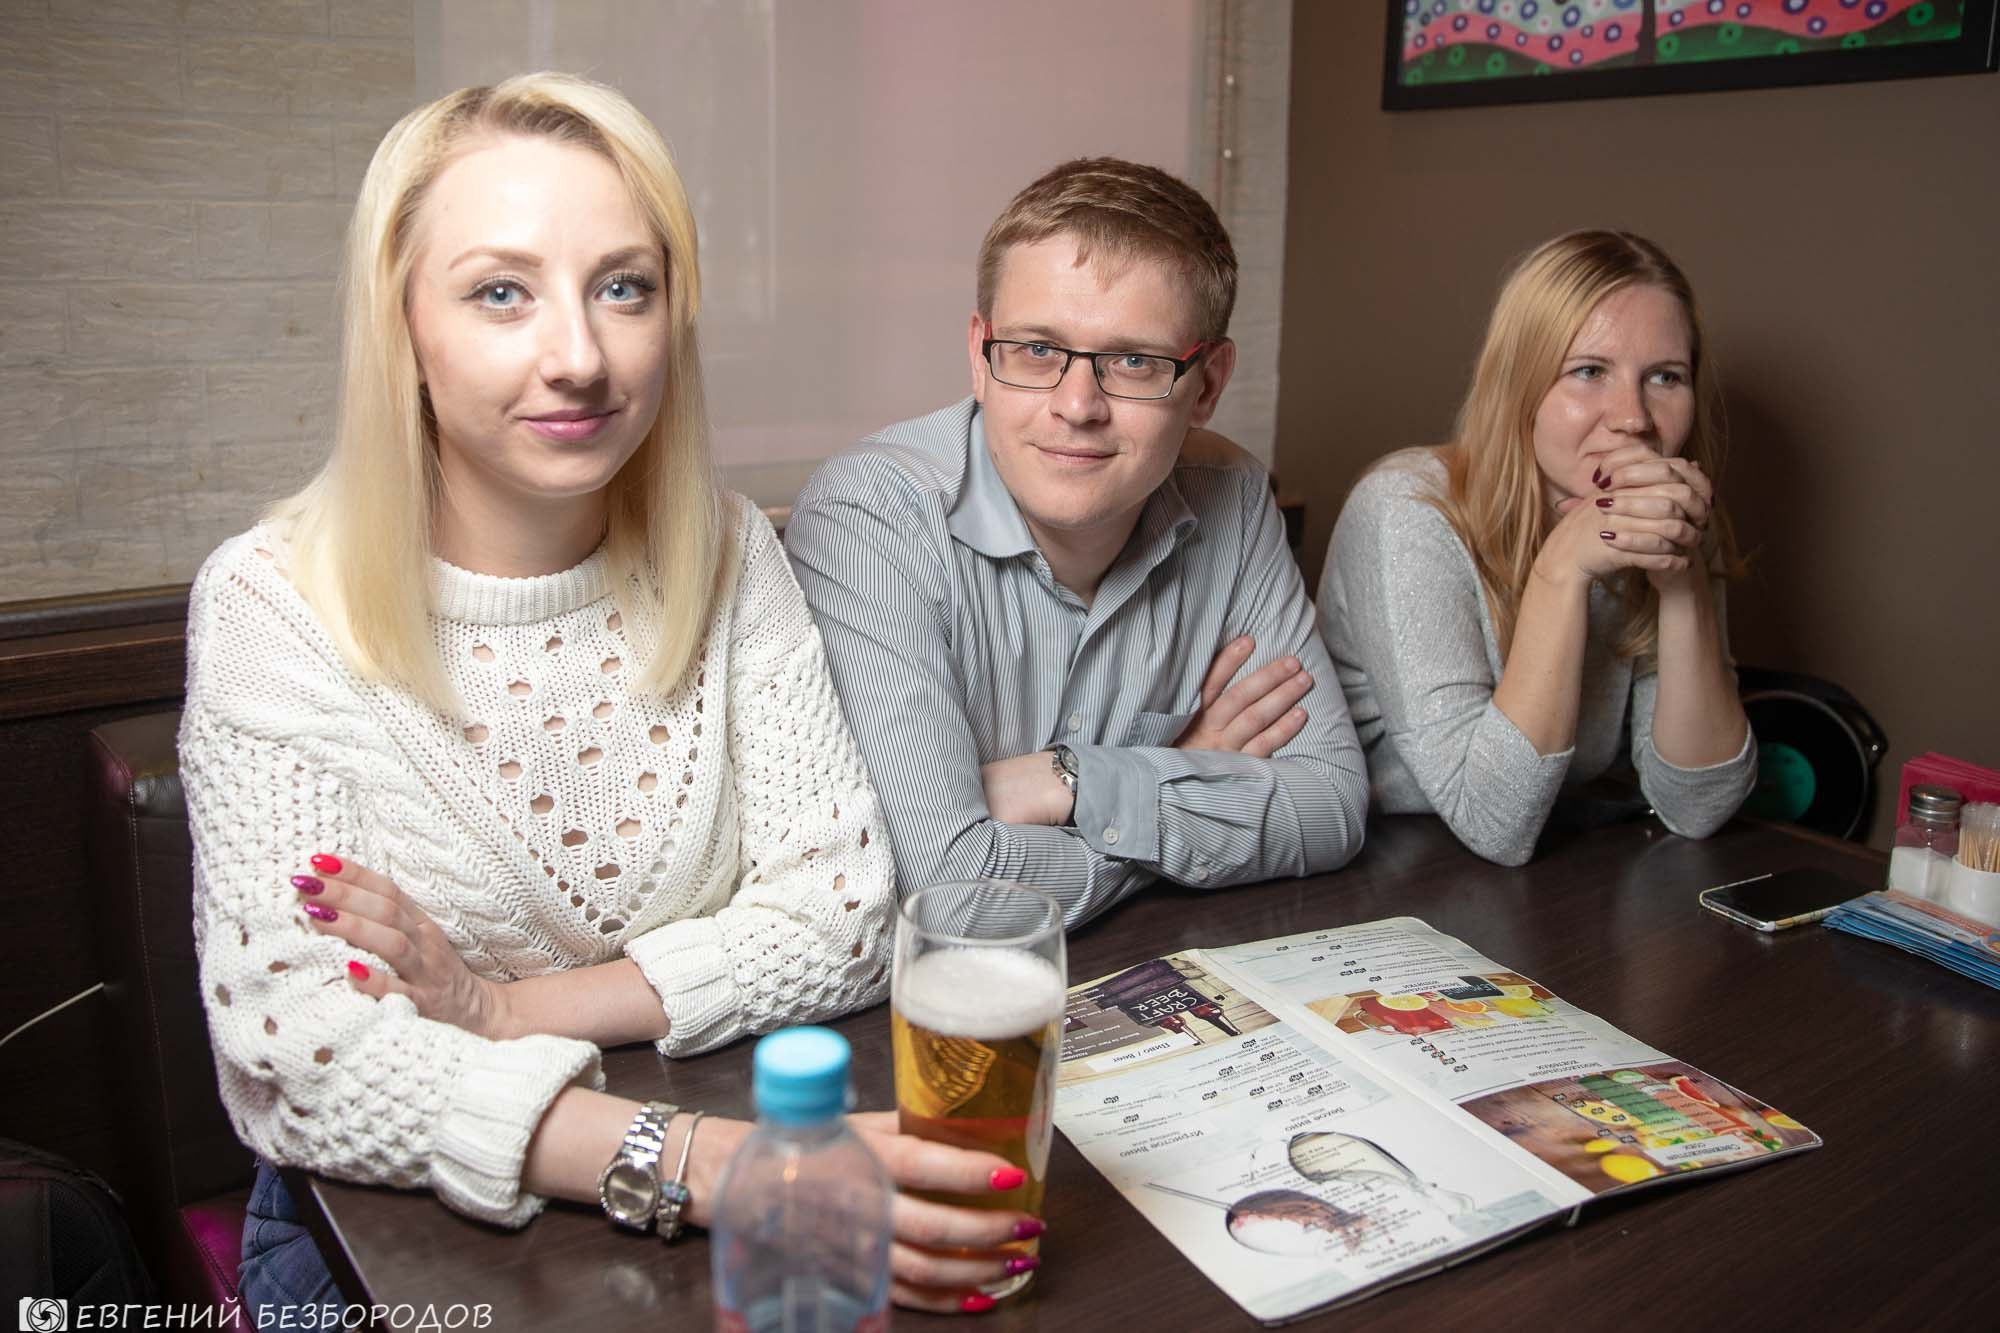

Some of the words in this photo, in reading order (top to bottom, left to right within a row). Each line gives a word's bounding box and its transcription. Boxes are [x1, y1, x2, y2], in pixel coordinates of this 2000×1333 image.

[1129, 988, 1188, 1012] BEER
[1139, 996, 1197, 1022] CRAFT
[1143, 1041, 1171, 1054] Пиво
[1112, 1052, 1136, 1063] Beer
[1313, 1106, 1345, 1122] Белое
[1149, 1128, 1205, 1150] Игристое
